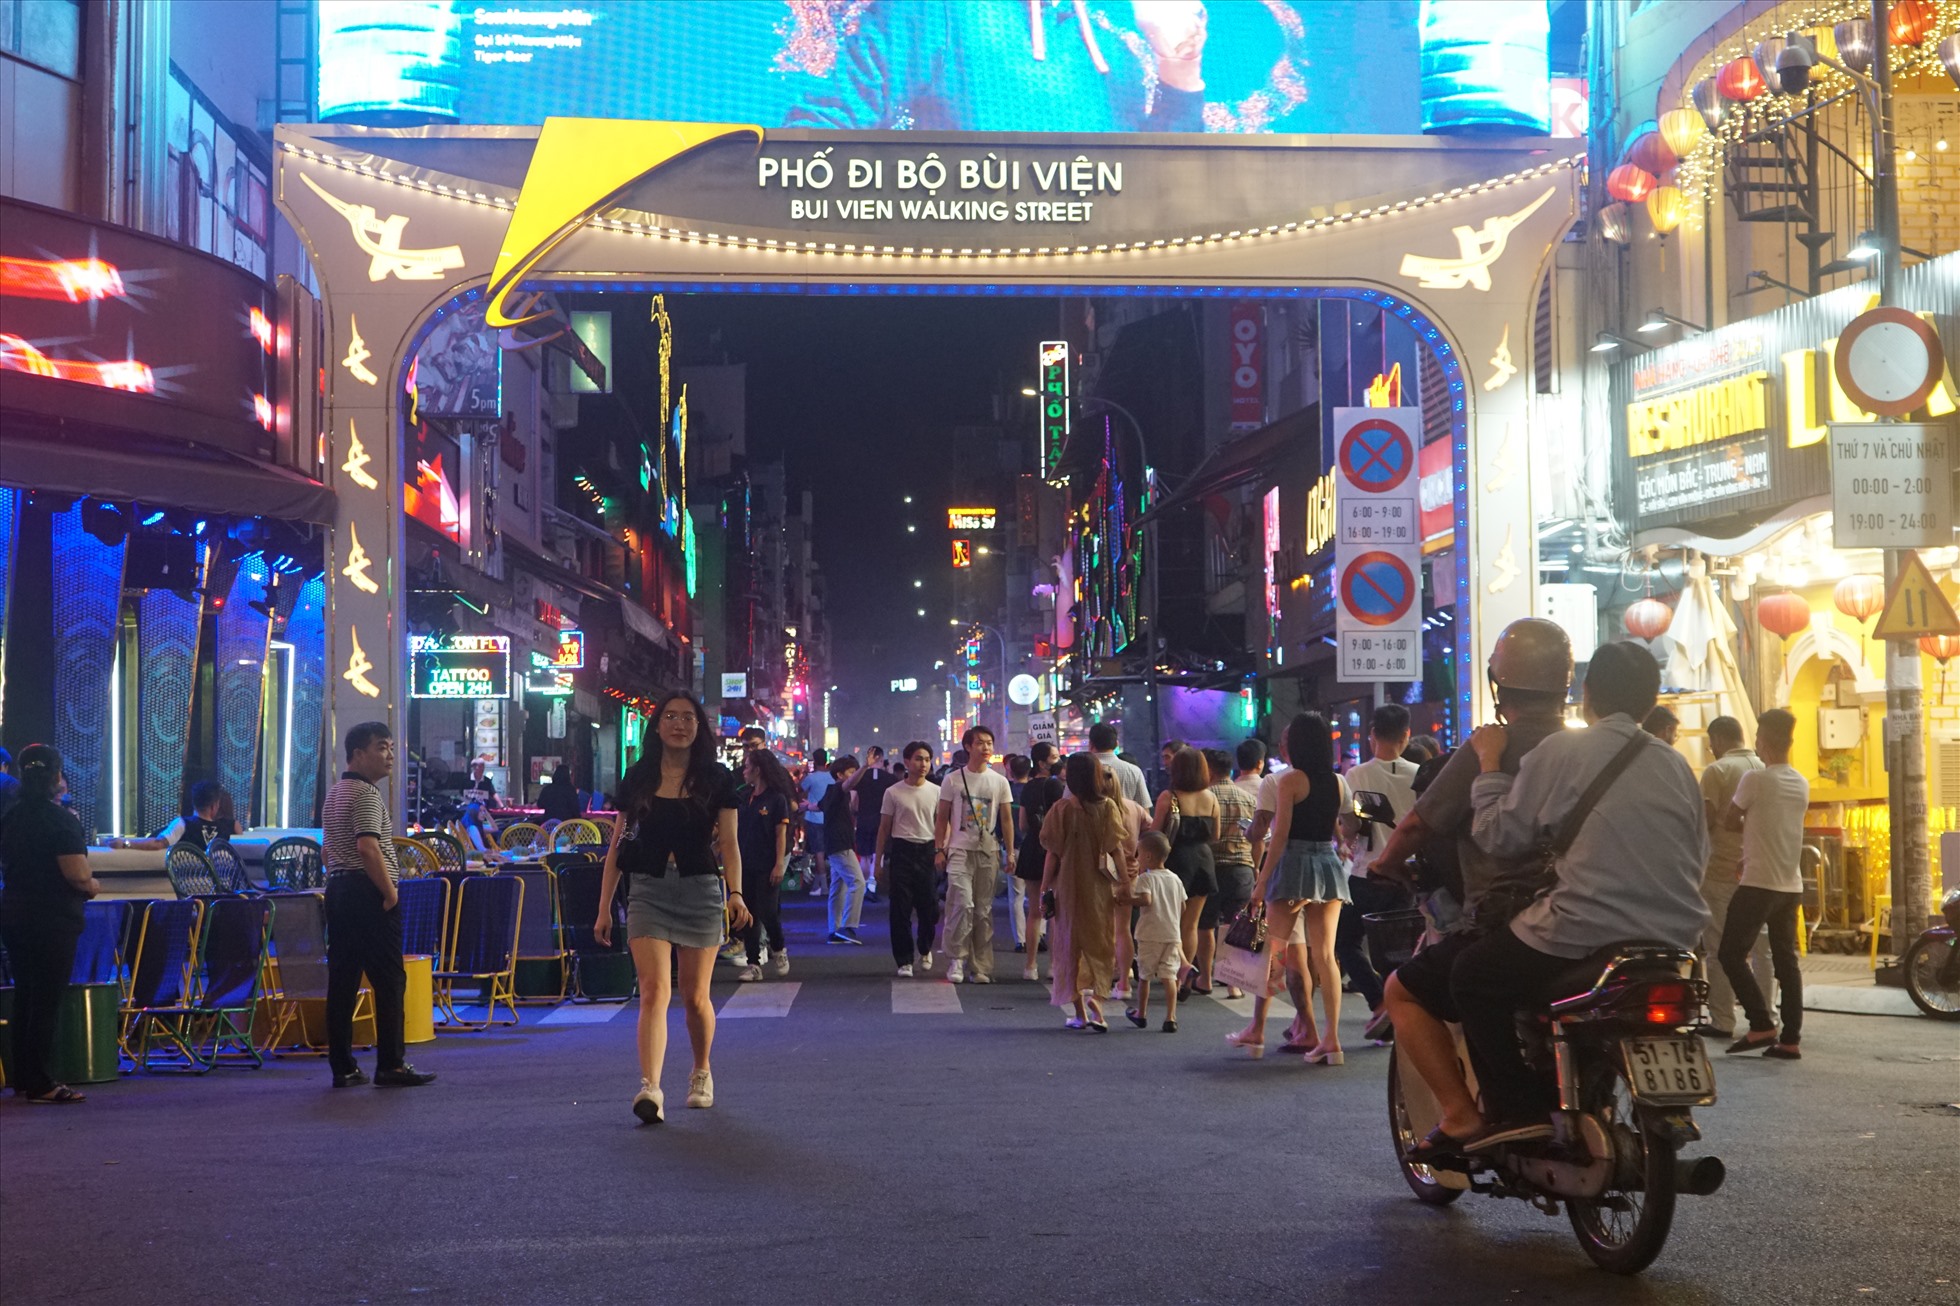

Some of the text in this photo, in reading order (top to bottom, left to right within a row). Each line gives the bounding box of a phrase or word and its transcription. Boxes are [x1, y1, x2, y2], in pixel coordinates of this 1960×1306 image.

[759, 147, 1122, 197] PHỐ ĐI BỘ BÙI VIỆN
[791, 200, 1093, 222] BUI VIEN WALKING STREET
[1234, 319, 1257, 389] OYO
[1627, 370, 1768, 458] RESTAURANT
[1837, 438, 1859, 459] THỨ
[1863, 442, 1869, 459] 7
[1873, 438, 1888, 459] VÀ
[1917, 437, 1945, 462] NHẬT
[1703, 459, 1738, 485] TRUNG
[1745, 452, 1768, 475] NAM
[1853, 478, 1889, 494] 00:00
[1904, 478, 1932, 494] 2:00
[1353, 506, 1372, 518] 6:00
[1382, 506, 1402, 518] 9:00
[1850, 513, 1884, 530] 19:00
[1901, 513, 1937, 530] 24:00
[1348, 526, 1372, 538] 16:00
[1382, 526, 1406, 538] 19:00
[1352, 639, 1372, 650] 9:00
[1383, 639, 1406, 650] 16:00
[1352, 658, 1376, 670] 19:00
[1386, 658, 1406, 670] 6:00
[431, 668, 490, 682] TATTOO
[429, 681, 492, 695] OPEN 24H
[891, 678, 917, 692] PUB
[1644, 1068, 1701, 1091] 8186
